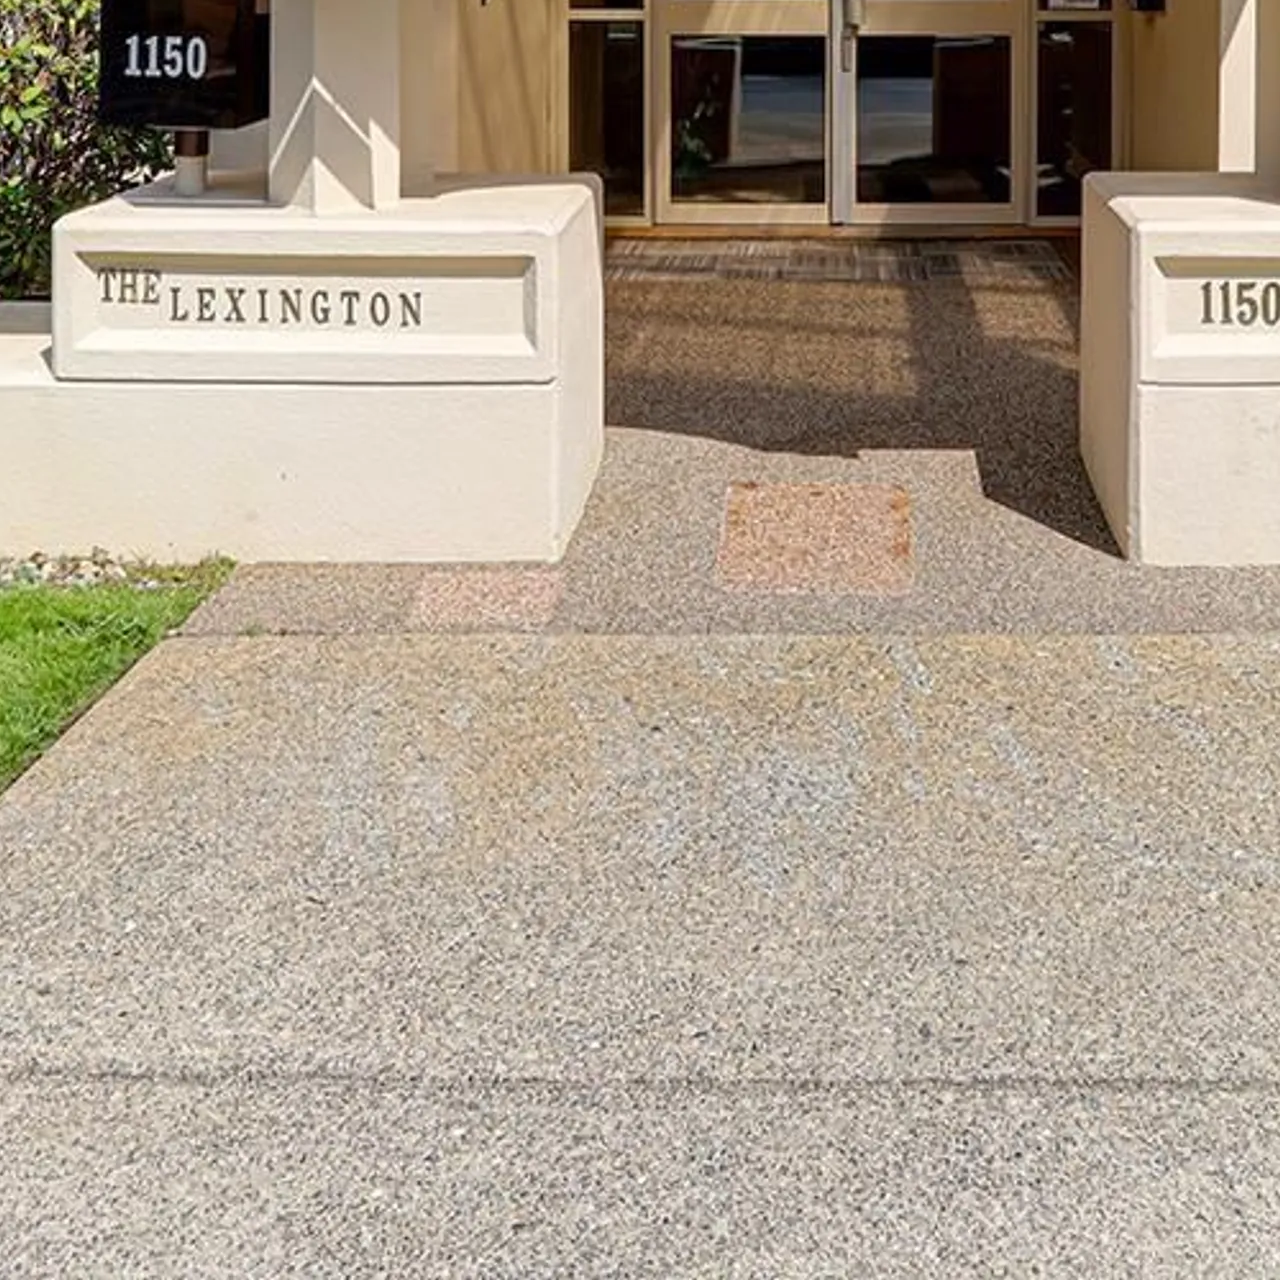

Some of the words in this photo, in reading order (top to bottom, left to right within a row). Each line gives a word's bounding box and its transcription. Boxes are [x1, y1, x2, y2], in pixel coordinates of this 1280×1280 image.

[125, 35, 207, 80] 1150
[97, 267, 161, 304] THE
[169, 286, 422, 327] LEXINGTON
